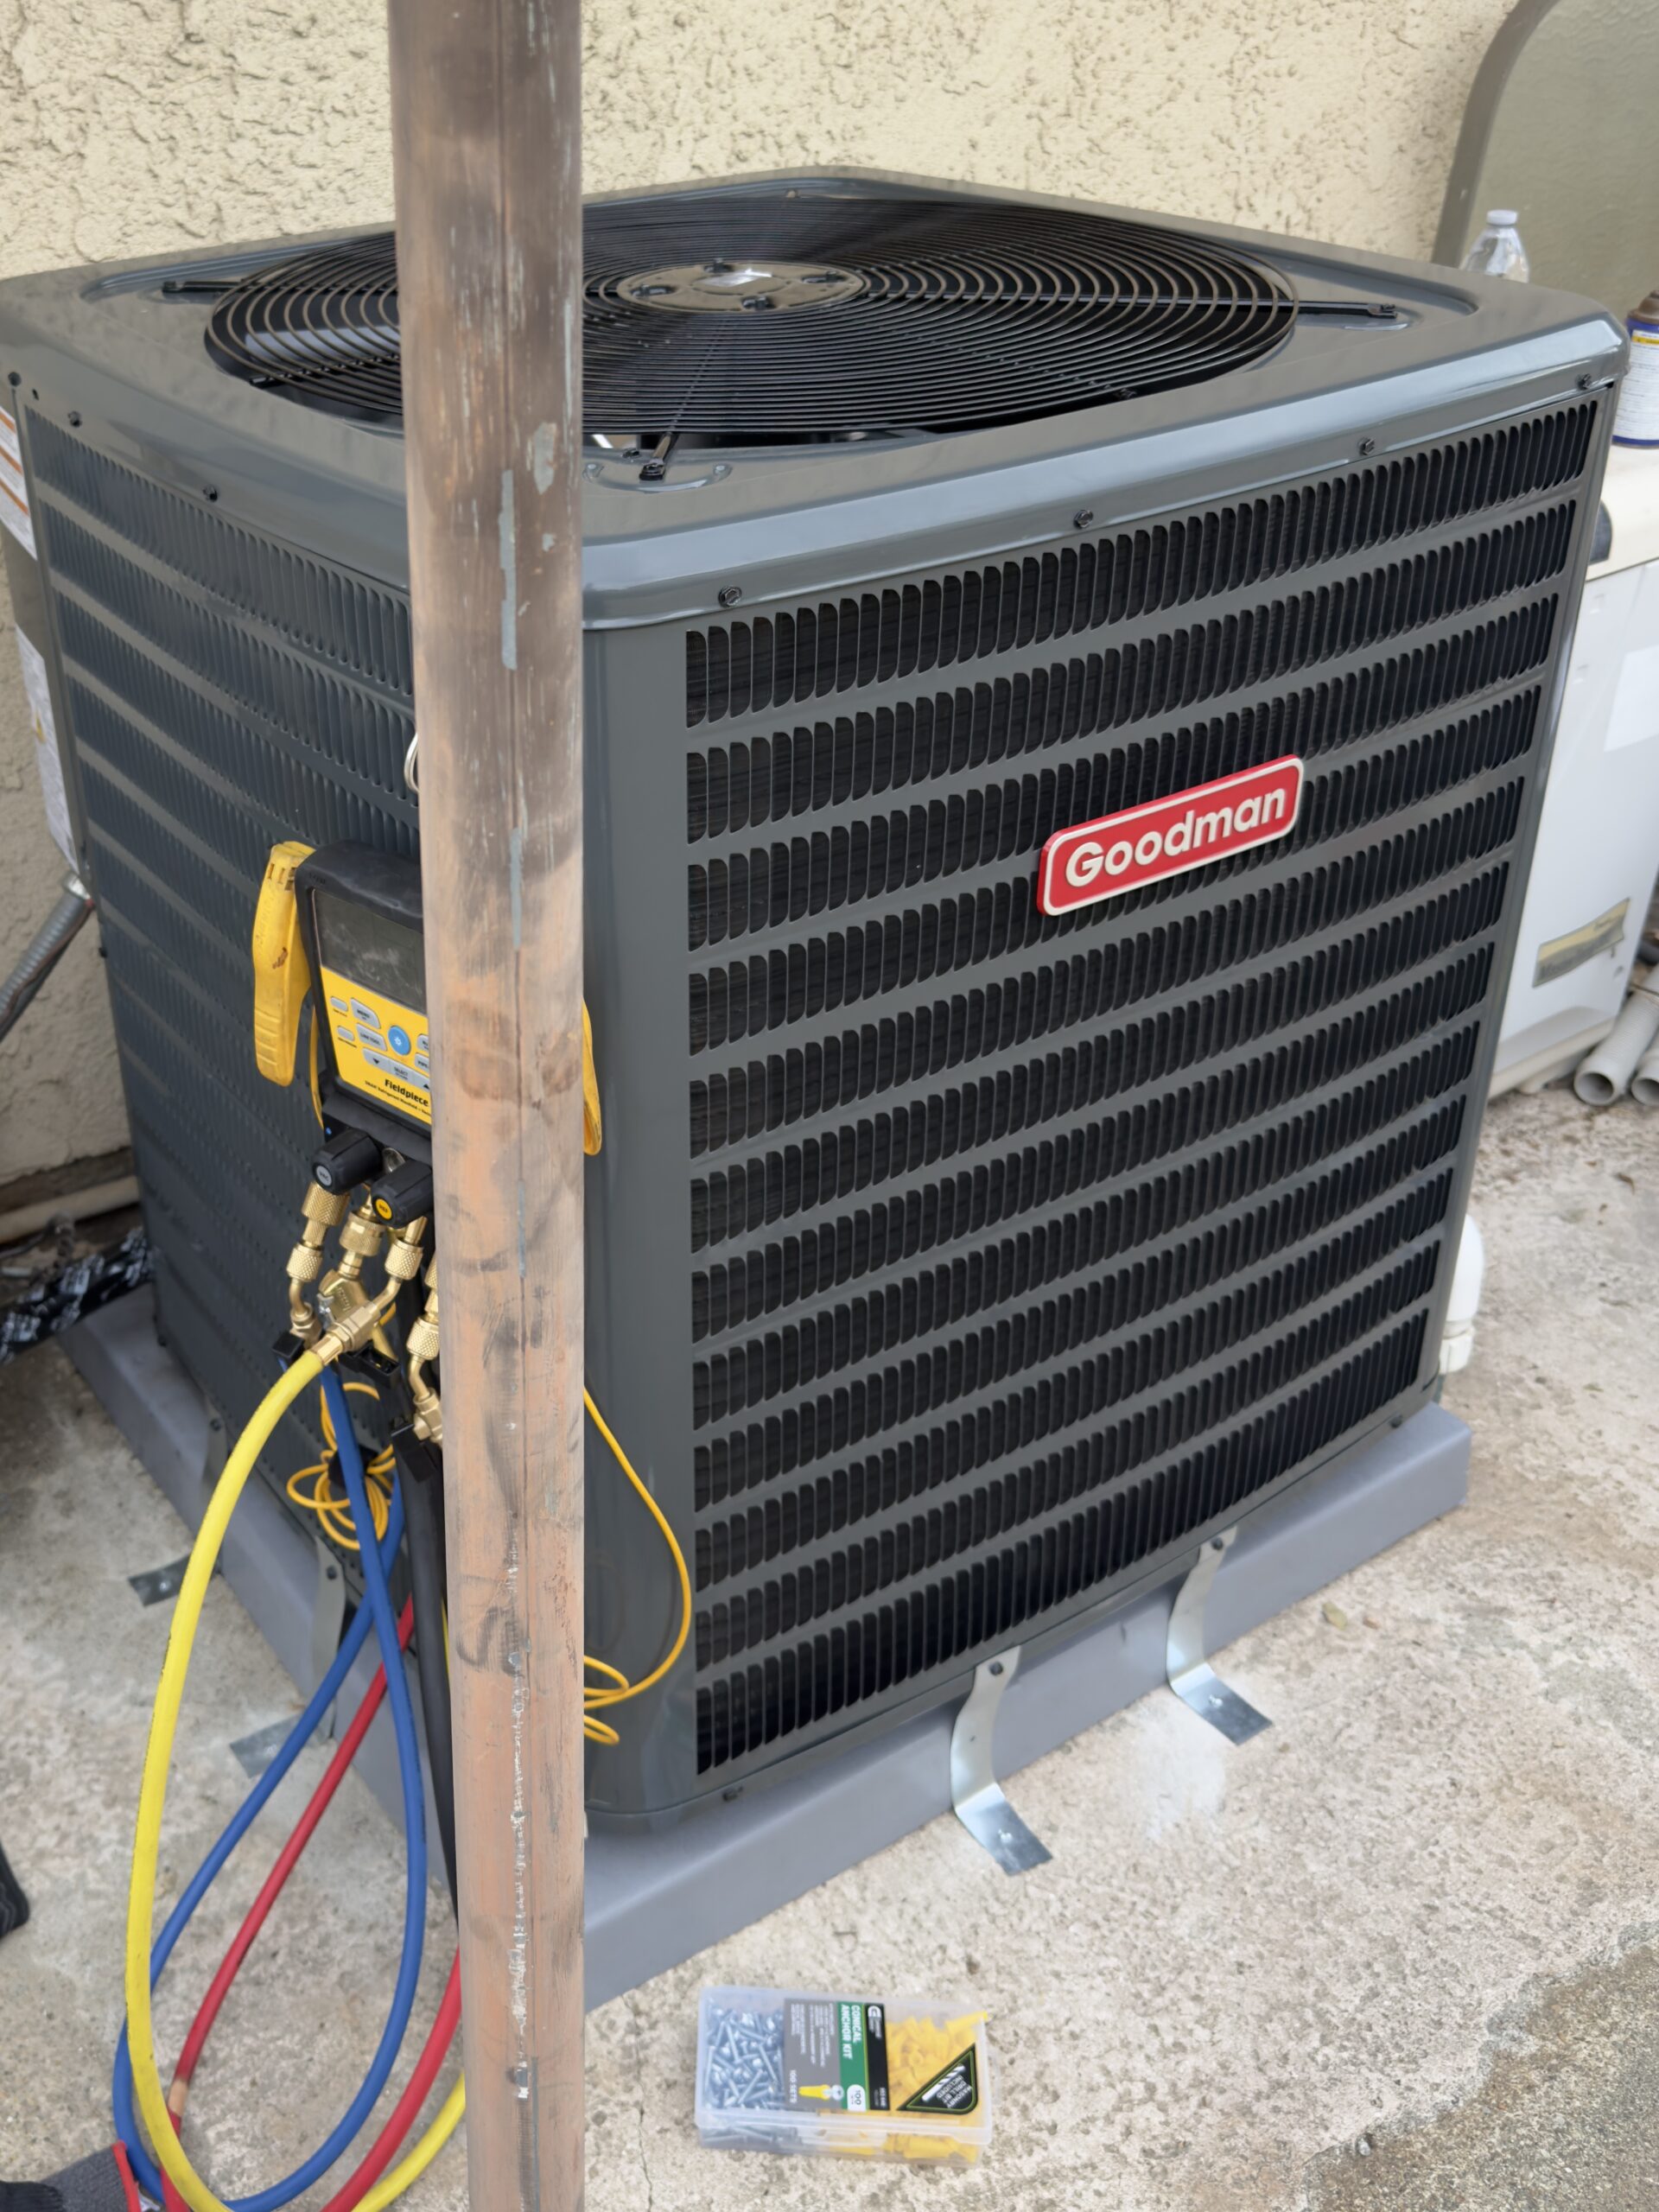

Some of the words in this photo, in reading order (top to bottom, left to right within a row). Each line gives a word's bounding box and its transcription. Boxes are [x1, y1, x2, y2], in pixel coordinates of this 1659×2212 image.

[1065, 788, 1286, 887] Goodman
[385, 1078, 429, 1107] Fieldpiece
[841, 2004, 852, 2041] ANCHOR
[852, 2005, 862, 2044] CONICAL
[842, 2043, 853, 2060] KIT
[936, 2074, 964, 2099] INCLUDED
[942, 2093, 953, 2103] BIT
[947, 2084, 973, 2108] MASONRY
[951, 2080, 967, 2095] DRILL
